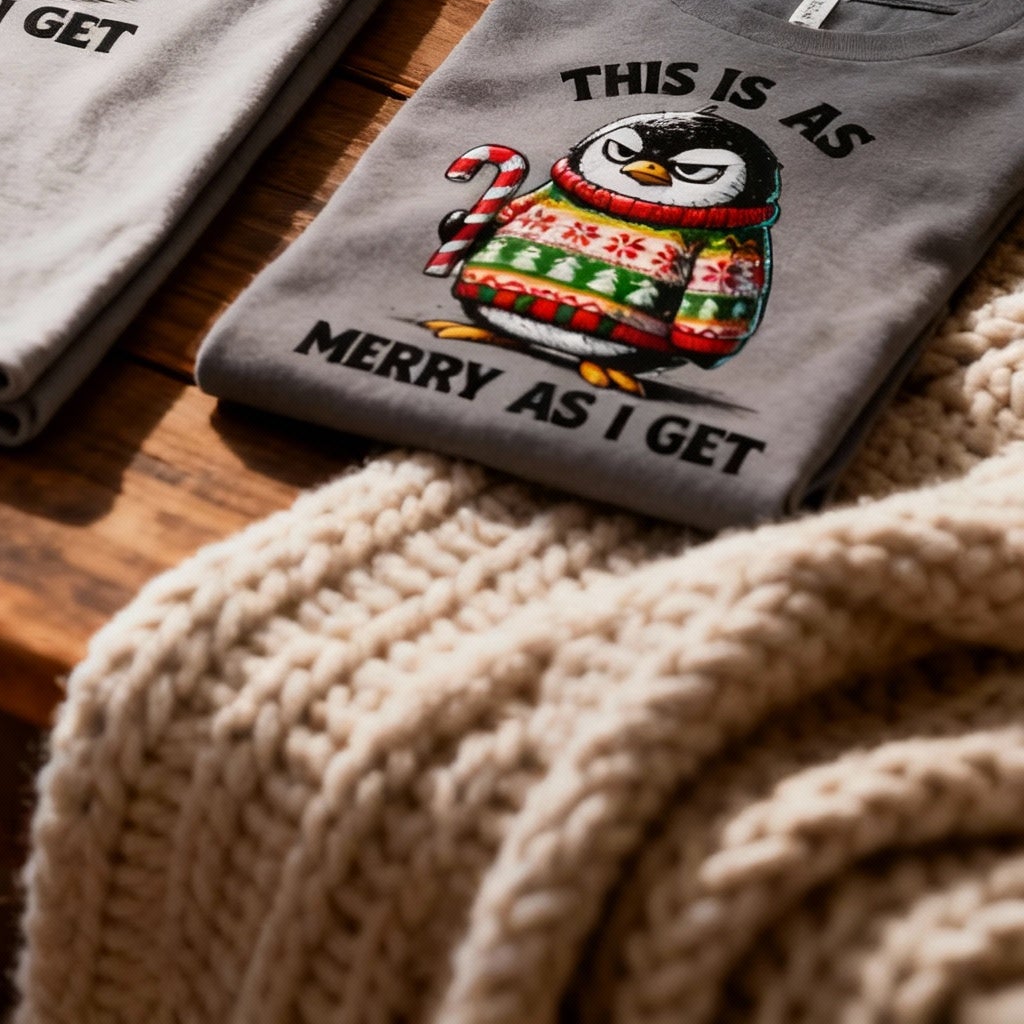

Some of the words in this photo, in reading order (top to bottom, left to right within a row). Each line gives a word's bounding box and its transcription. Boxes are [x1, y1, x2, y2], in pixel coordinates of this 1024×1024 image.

[23, 6, 139, 54] GET
[560, 61, 699, 102] THIS
[709, 67, 776, 110] IS
[780, 102, 876, 159] AS
[293, 321, 503, 399] MERRY
[506, 381, 597, 428] AS
[604, 405, 634, 441] I
[645, 414, 767, 476] GET
